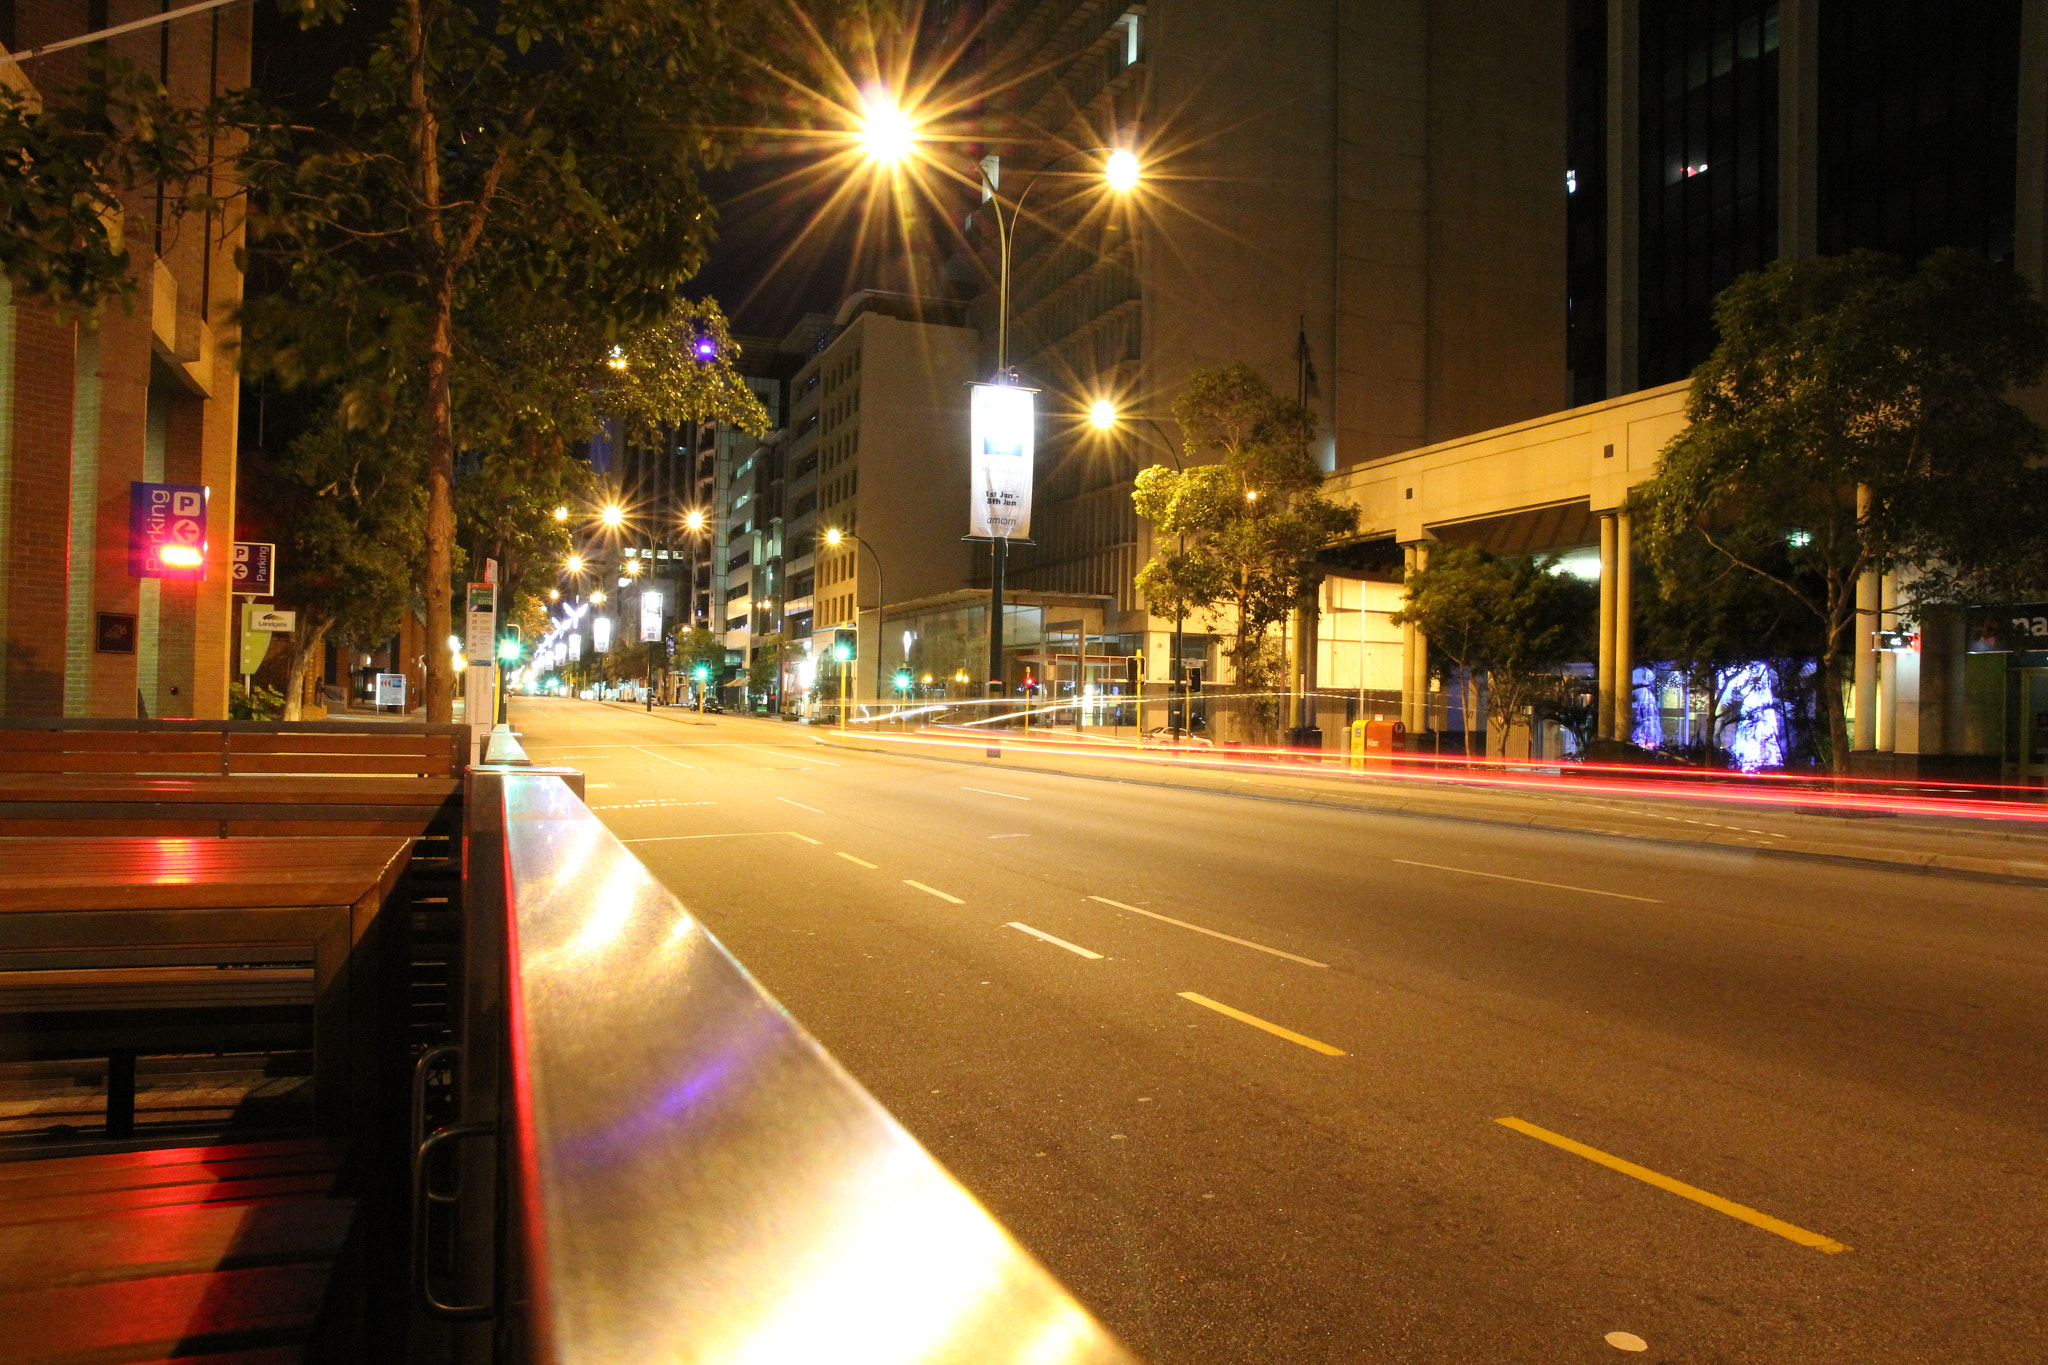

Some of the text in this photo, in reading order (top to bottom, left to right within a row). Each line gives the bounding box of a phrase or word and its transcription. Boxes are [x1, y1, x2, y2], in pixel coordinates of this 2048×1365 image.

[146, 490, 170, 572] Parking
[256, 546, 270, 582] Parking
[258, 620, 288, 629] Landgate
[1367, 740, 1379, 748] POST
